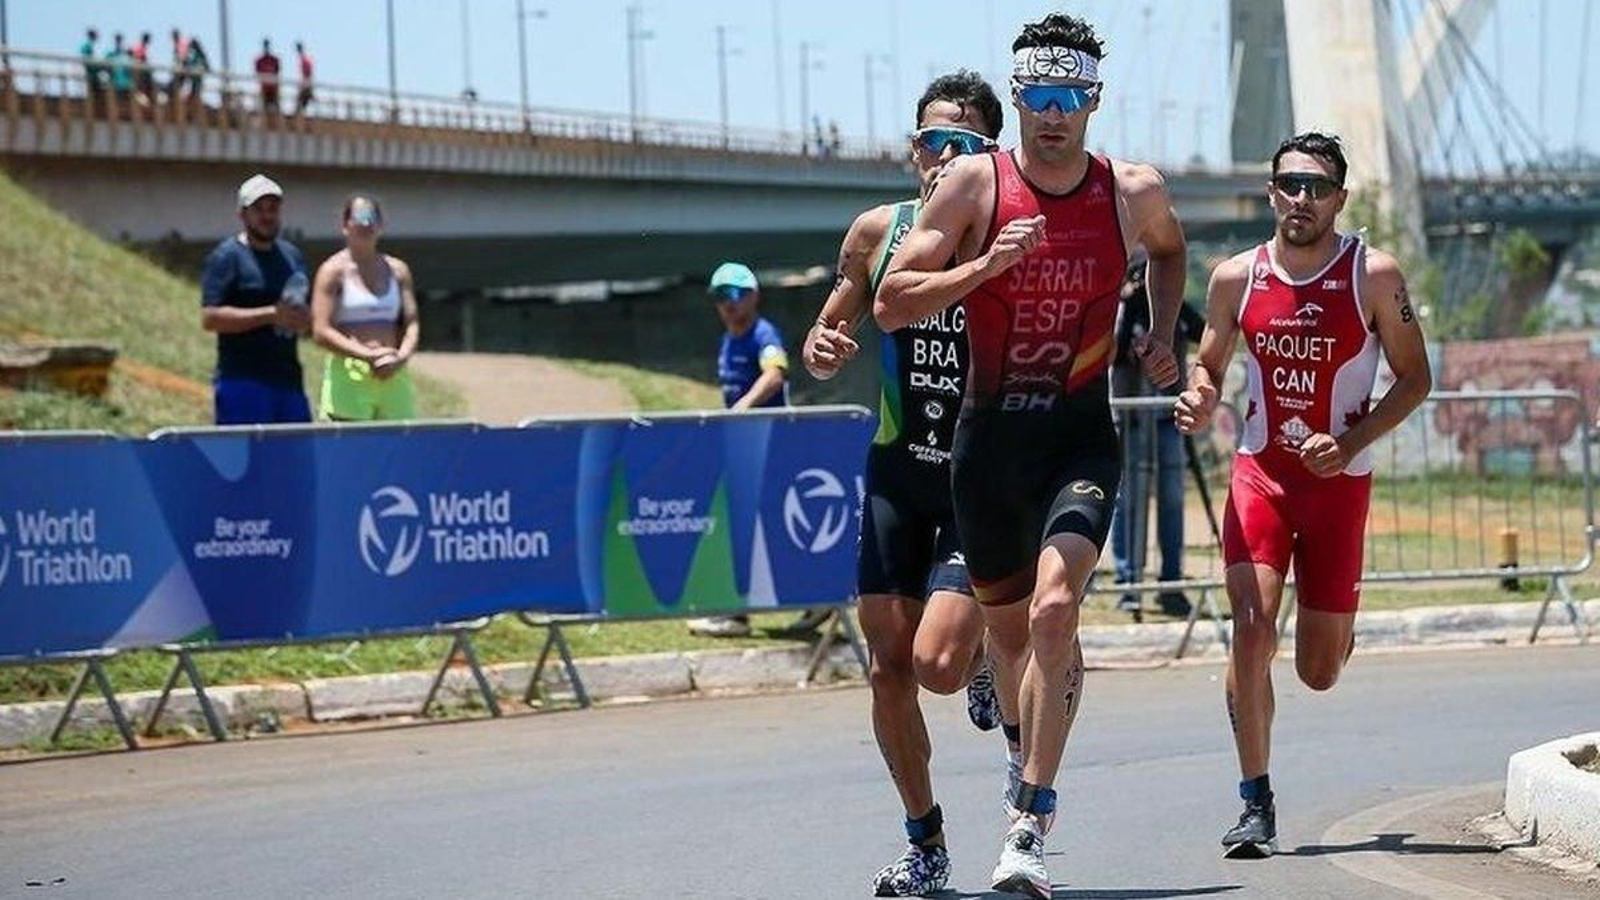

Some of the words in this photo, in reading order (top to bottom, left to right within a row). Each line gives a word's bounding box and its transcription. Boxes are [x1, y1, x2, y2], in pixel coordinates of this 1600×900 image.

[1009, 258, 1096, 292] SERRAT
[1013, 299, 1080, 333] ESP
[1400, 305, 1412, 323] 8
[913, 339, 960, 369] BRA
[1255, 332, 1337, 362] PAQUET
[910, 372, 961, 395] DUX
[1272, 366, 1316, 394] CAN
[1002, 393, 1056, 411] BH
[428, 490, 510, 525] World
[638, 497, 658, 517] Be
[660, 499, 695, 519] your
[16, 508, 96, 545] World
[215, 516, 236, 538] Be
[237, 519, 271, 540] your
[617, 516, 717, 536] extraordinary
[193, 538, 293, 559] extraordinary
[428, 526, 549, 562] Triathlon
[15, 548, 132, 586] Triathlon
